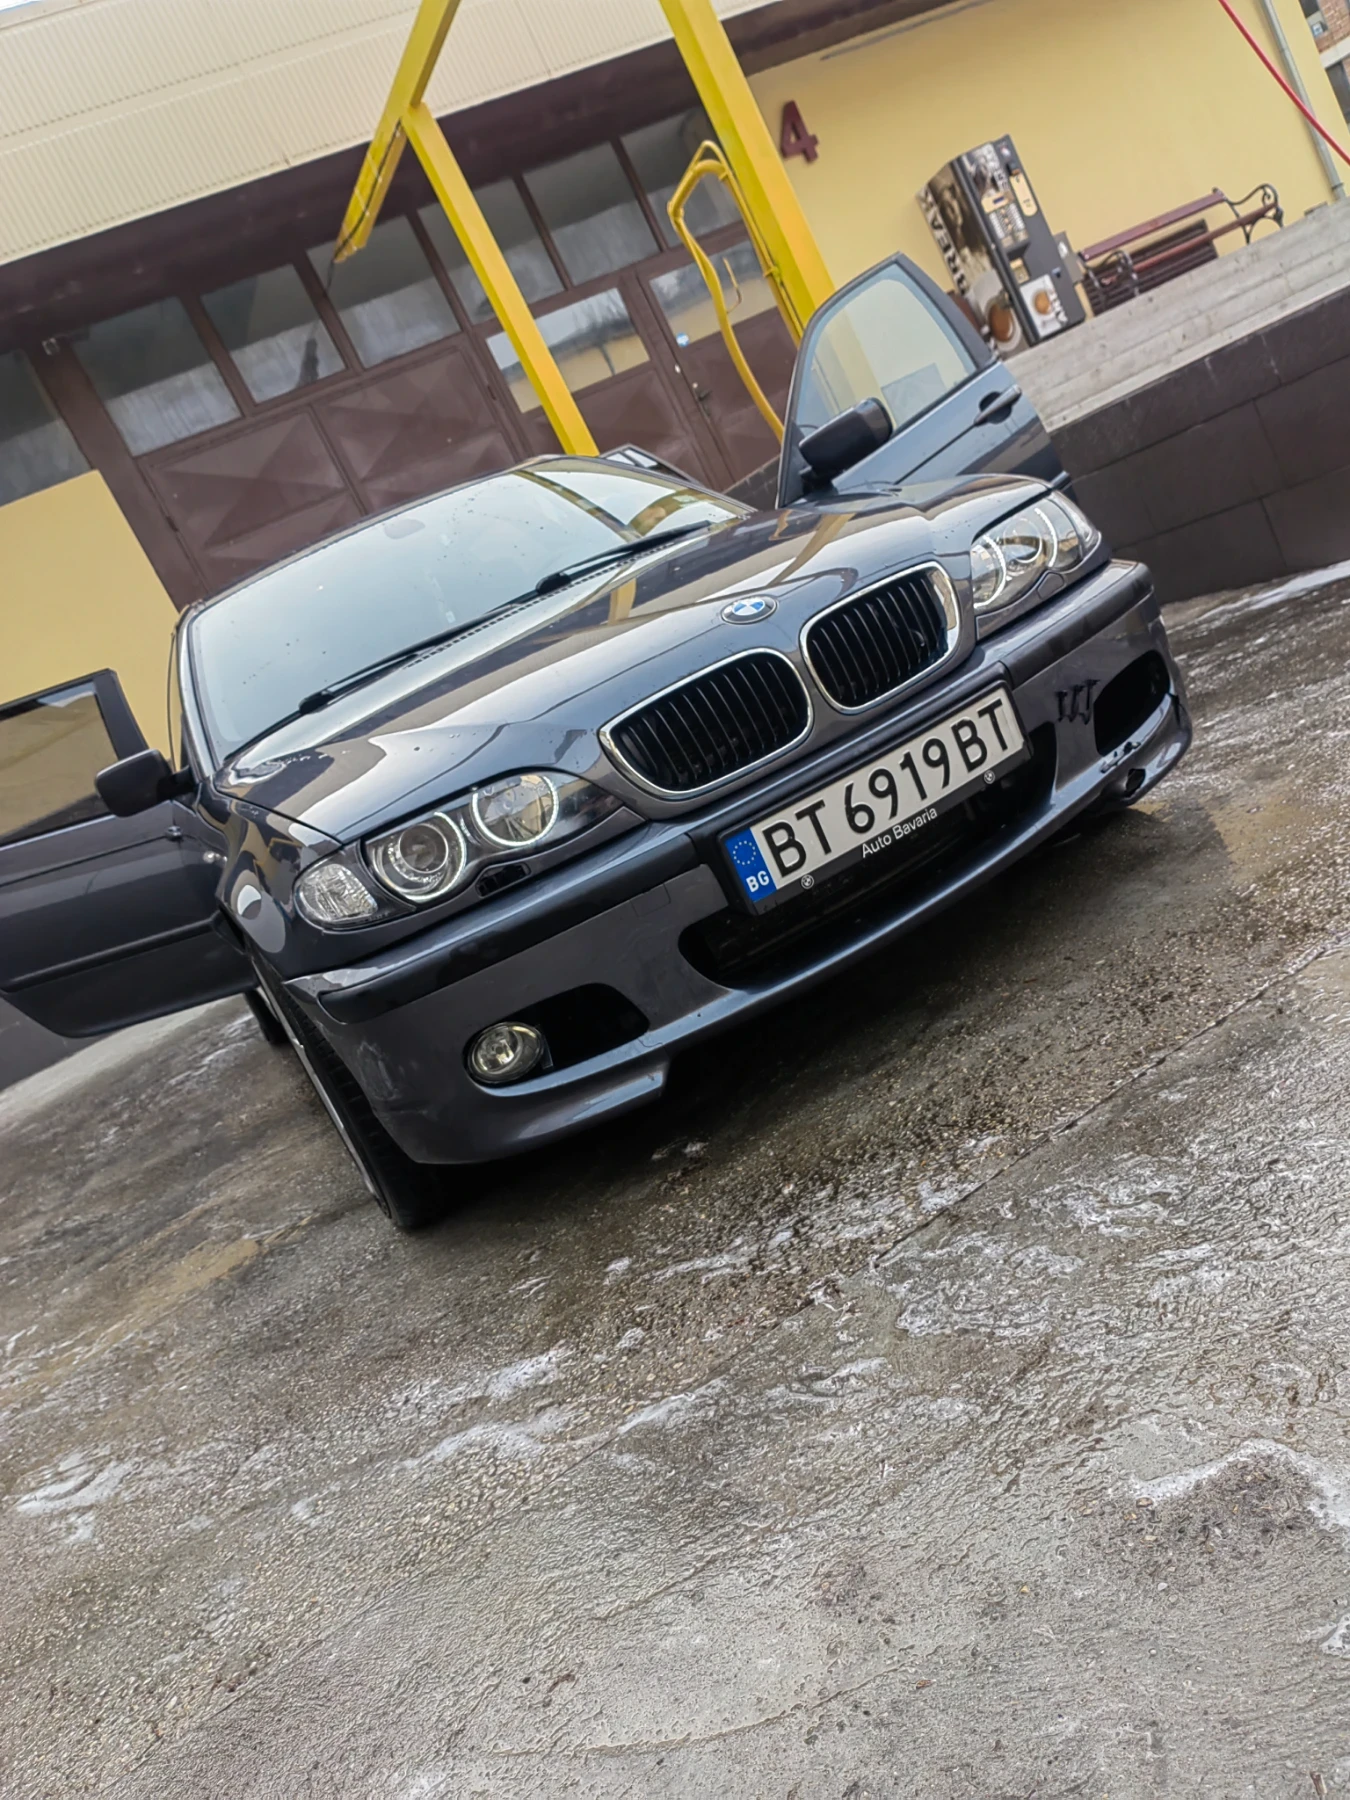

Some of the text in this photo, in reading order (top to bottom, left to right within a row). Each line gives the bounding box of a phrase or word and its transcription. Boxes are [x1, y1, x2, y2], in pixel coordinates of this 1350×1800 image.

[781, 100, 818, 163] 4
[762, 698, 1008, 878] BT 6919 BT
[861, 807, 938, 858] Auto Bavaria
[746, 870, 770, 892] BG
